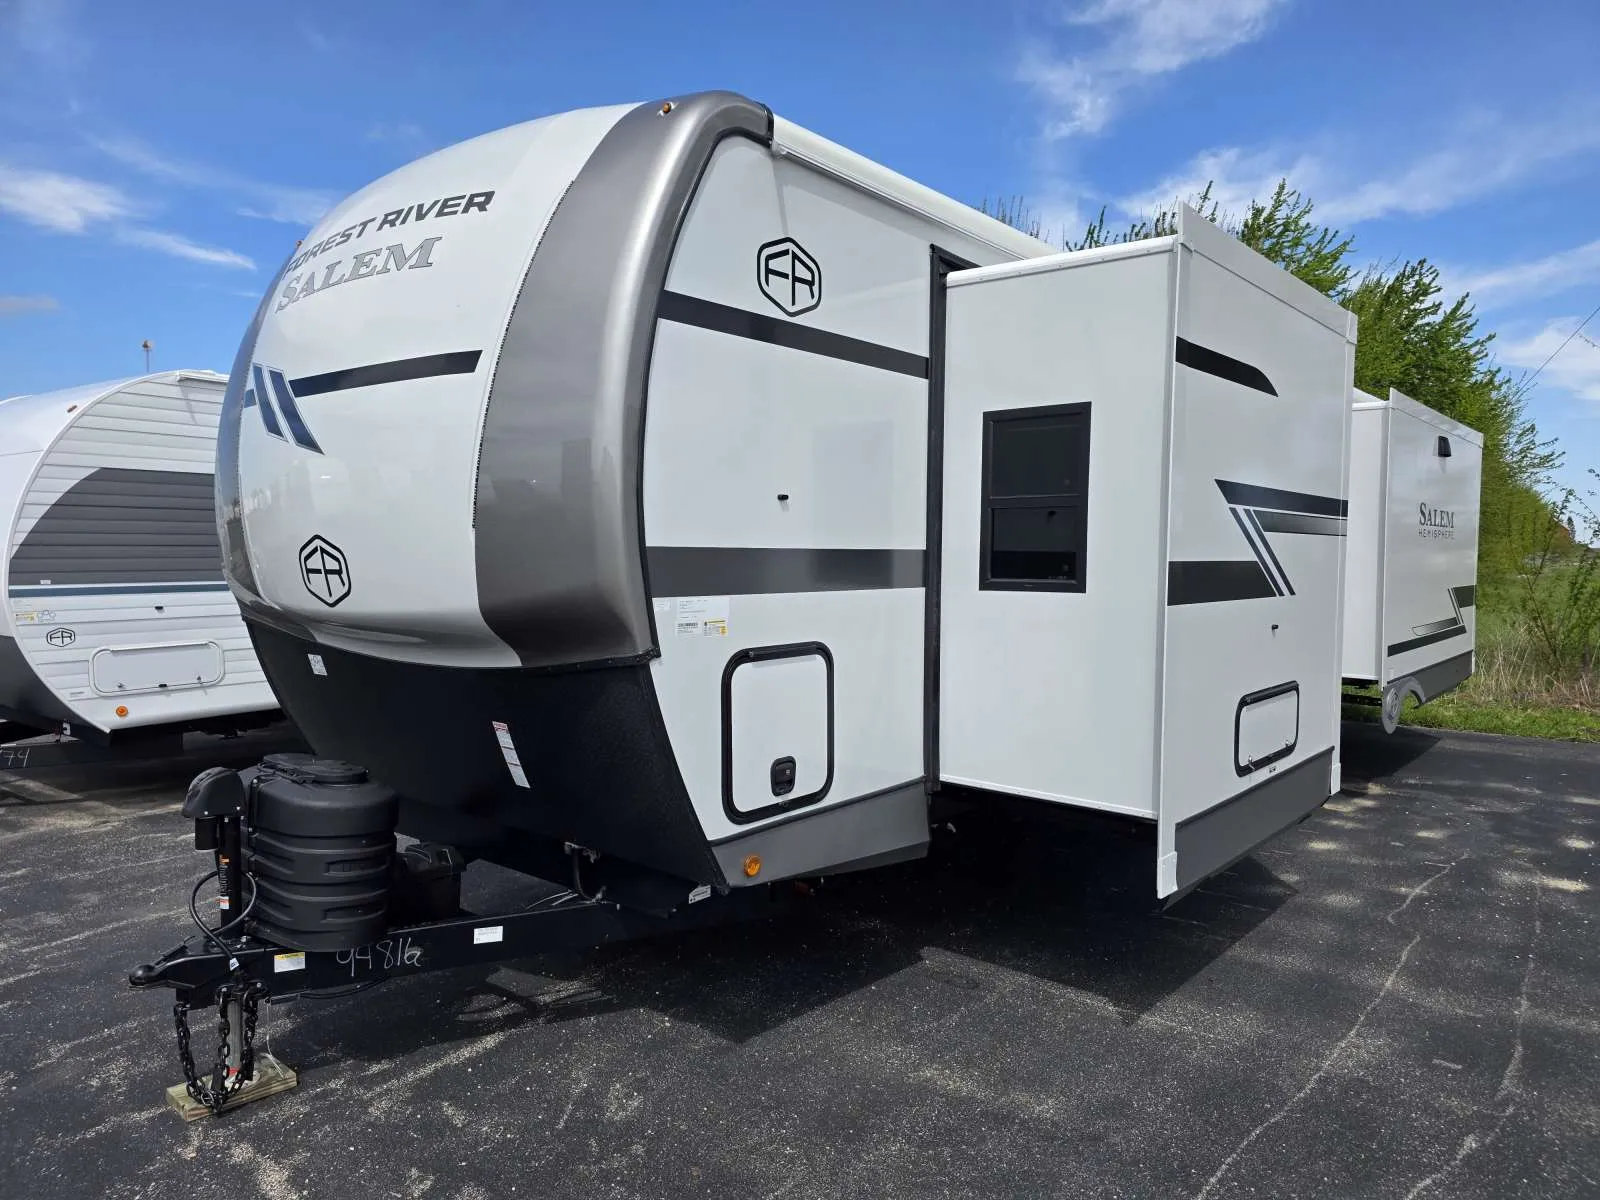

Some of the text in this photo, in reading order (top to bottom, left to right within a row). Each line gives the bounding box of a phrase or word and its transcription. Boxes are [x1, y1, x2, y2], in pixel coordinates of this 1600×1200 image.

[281, 190, 496, 281] FOREST RIVER
[274, 236, 443, 314] SALEM
[764, 247, 816, 307] FR
[303, 544, 346, 598] FR
[49, 629, 74, 645] FR
